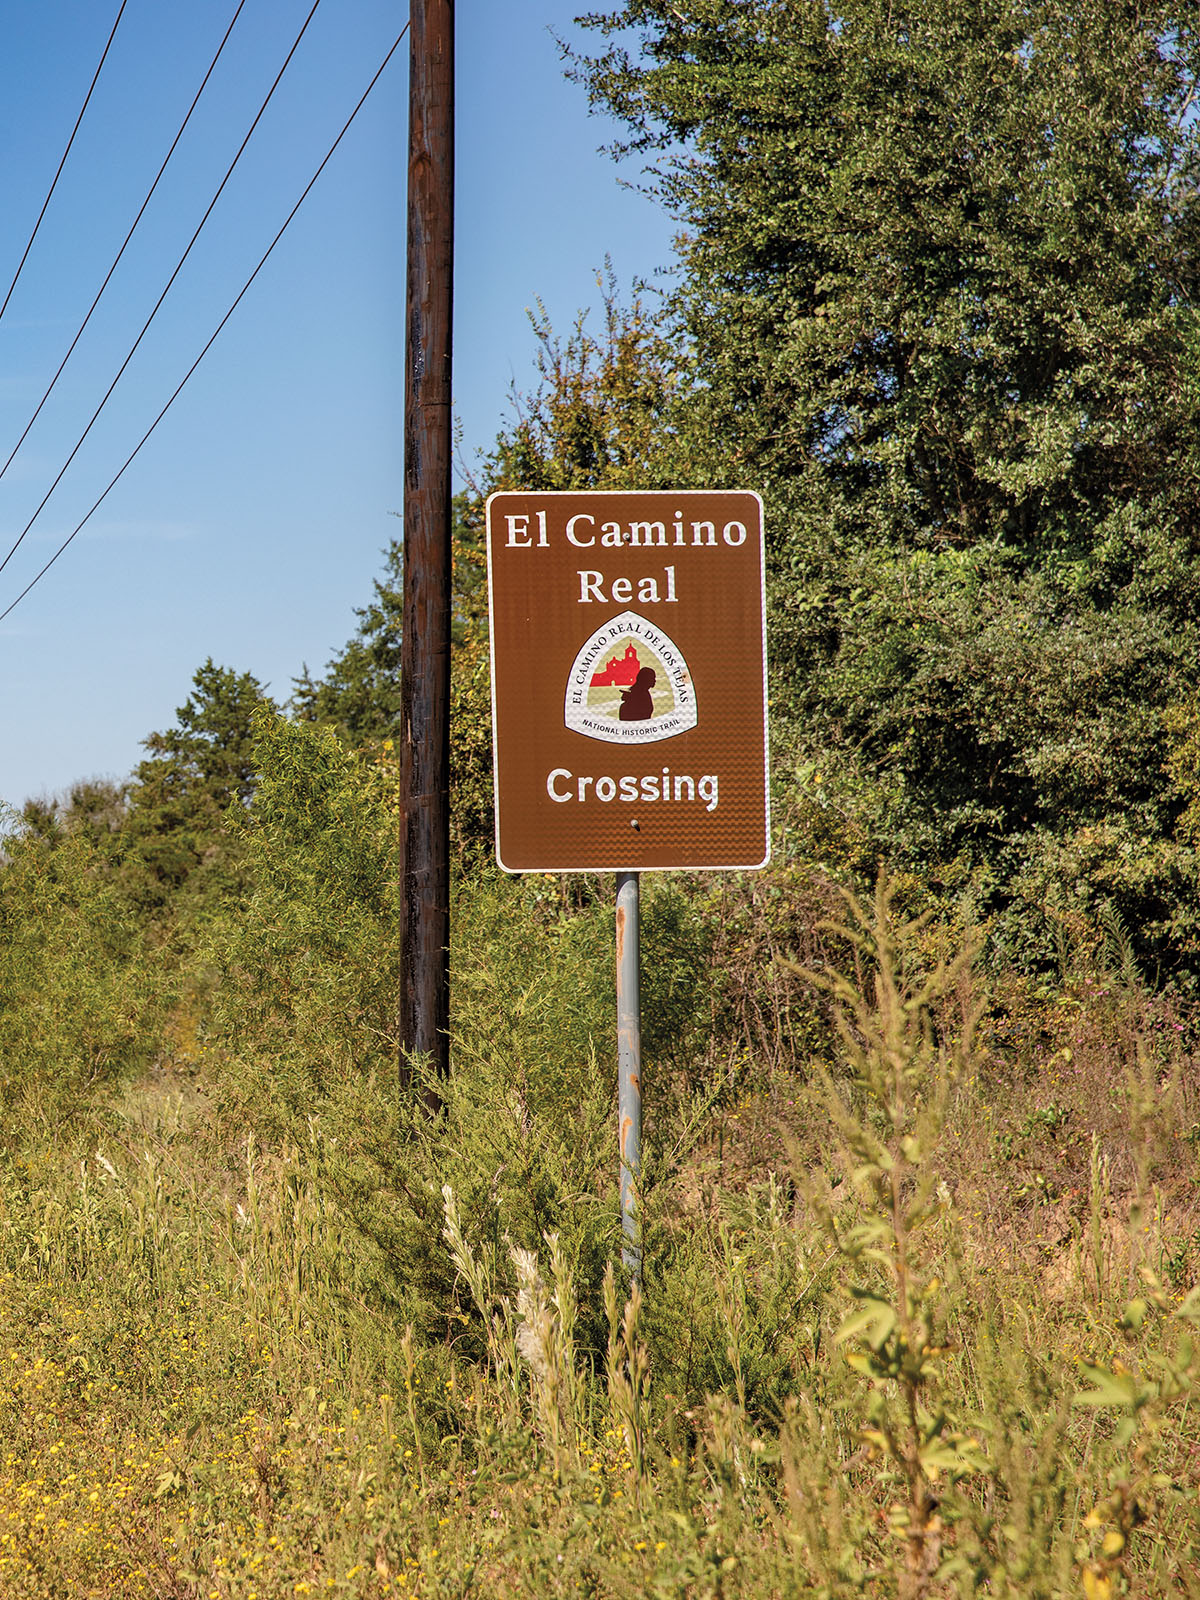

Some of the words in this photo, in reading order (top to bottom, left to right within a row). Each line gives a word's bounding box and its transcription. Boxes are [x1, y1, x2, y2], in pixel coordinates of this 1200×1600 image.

[504, 511, 550, 548] El
[566, 511, 747, 547] Camino
[577, 566, 678, 603] Real
[608, 622, 642, 638] REAL
[644, 630, 661, 646] DE
[575, 636, 607, 685] CAMINO
[658, 644, 677, 667] LOS
[572, 689, 583, 704] EL
[582, 719, 620, 735] NATIONAL
[622, 727, 658, 736] HISTORIC
[659, 719, 681, 731] TRAIL
[547, 767, 719, 812] Crossing
